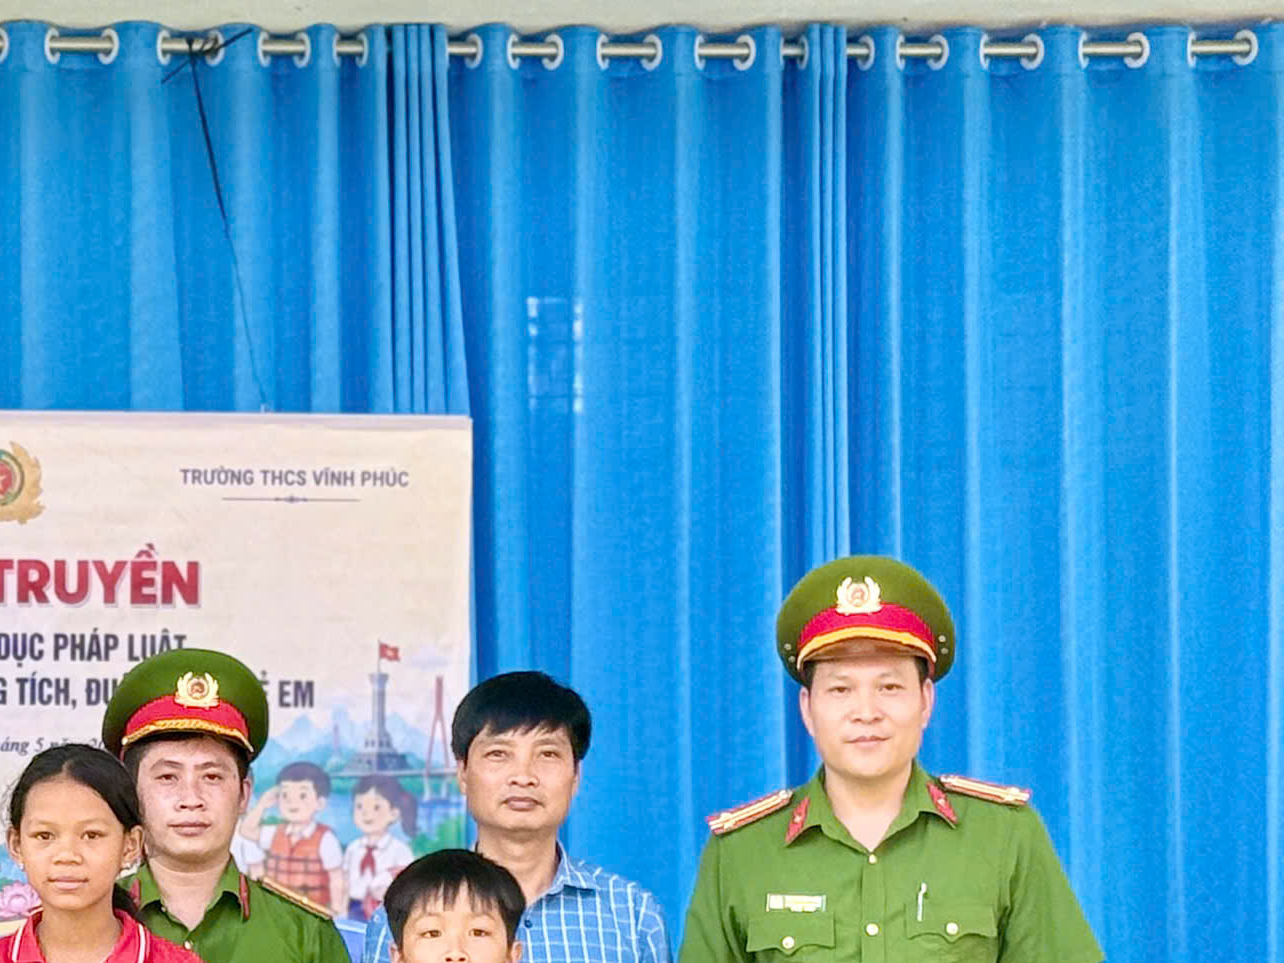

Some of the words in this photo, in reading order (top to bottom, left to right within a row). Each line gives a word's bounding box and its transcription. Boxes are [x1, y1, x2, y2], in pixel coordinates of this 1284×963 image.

[180, 465, 254, 486] TRƯỜNG
[260, 469, 307, 486] THCS
[312, 466, 355, 487] VĨNH
[360, 467, 409, 488] PHÚC
[53, 627, 119, 662] PHÁP
[16, 672, 77, 710] TÍCH,
[278, 680, 315, 708] EM
[34, 736, 44, 752] 5
